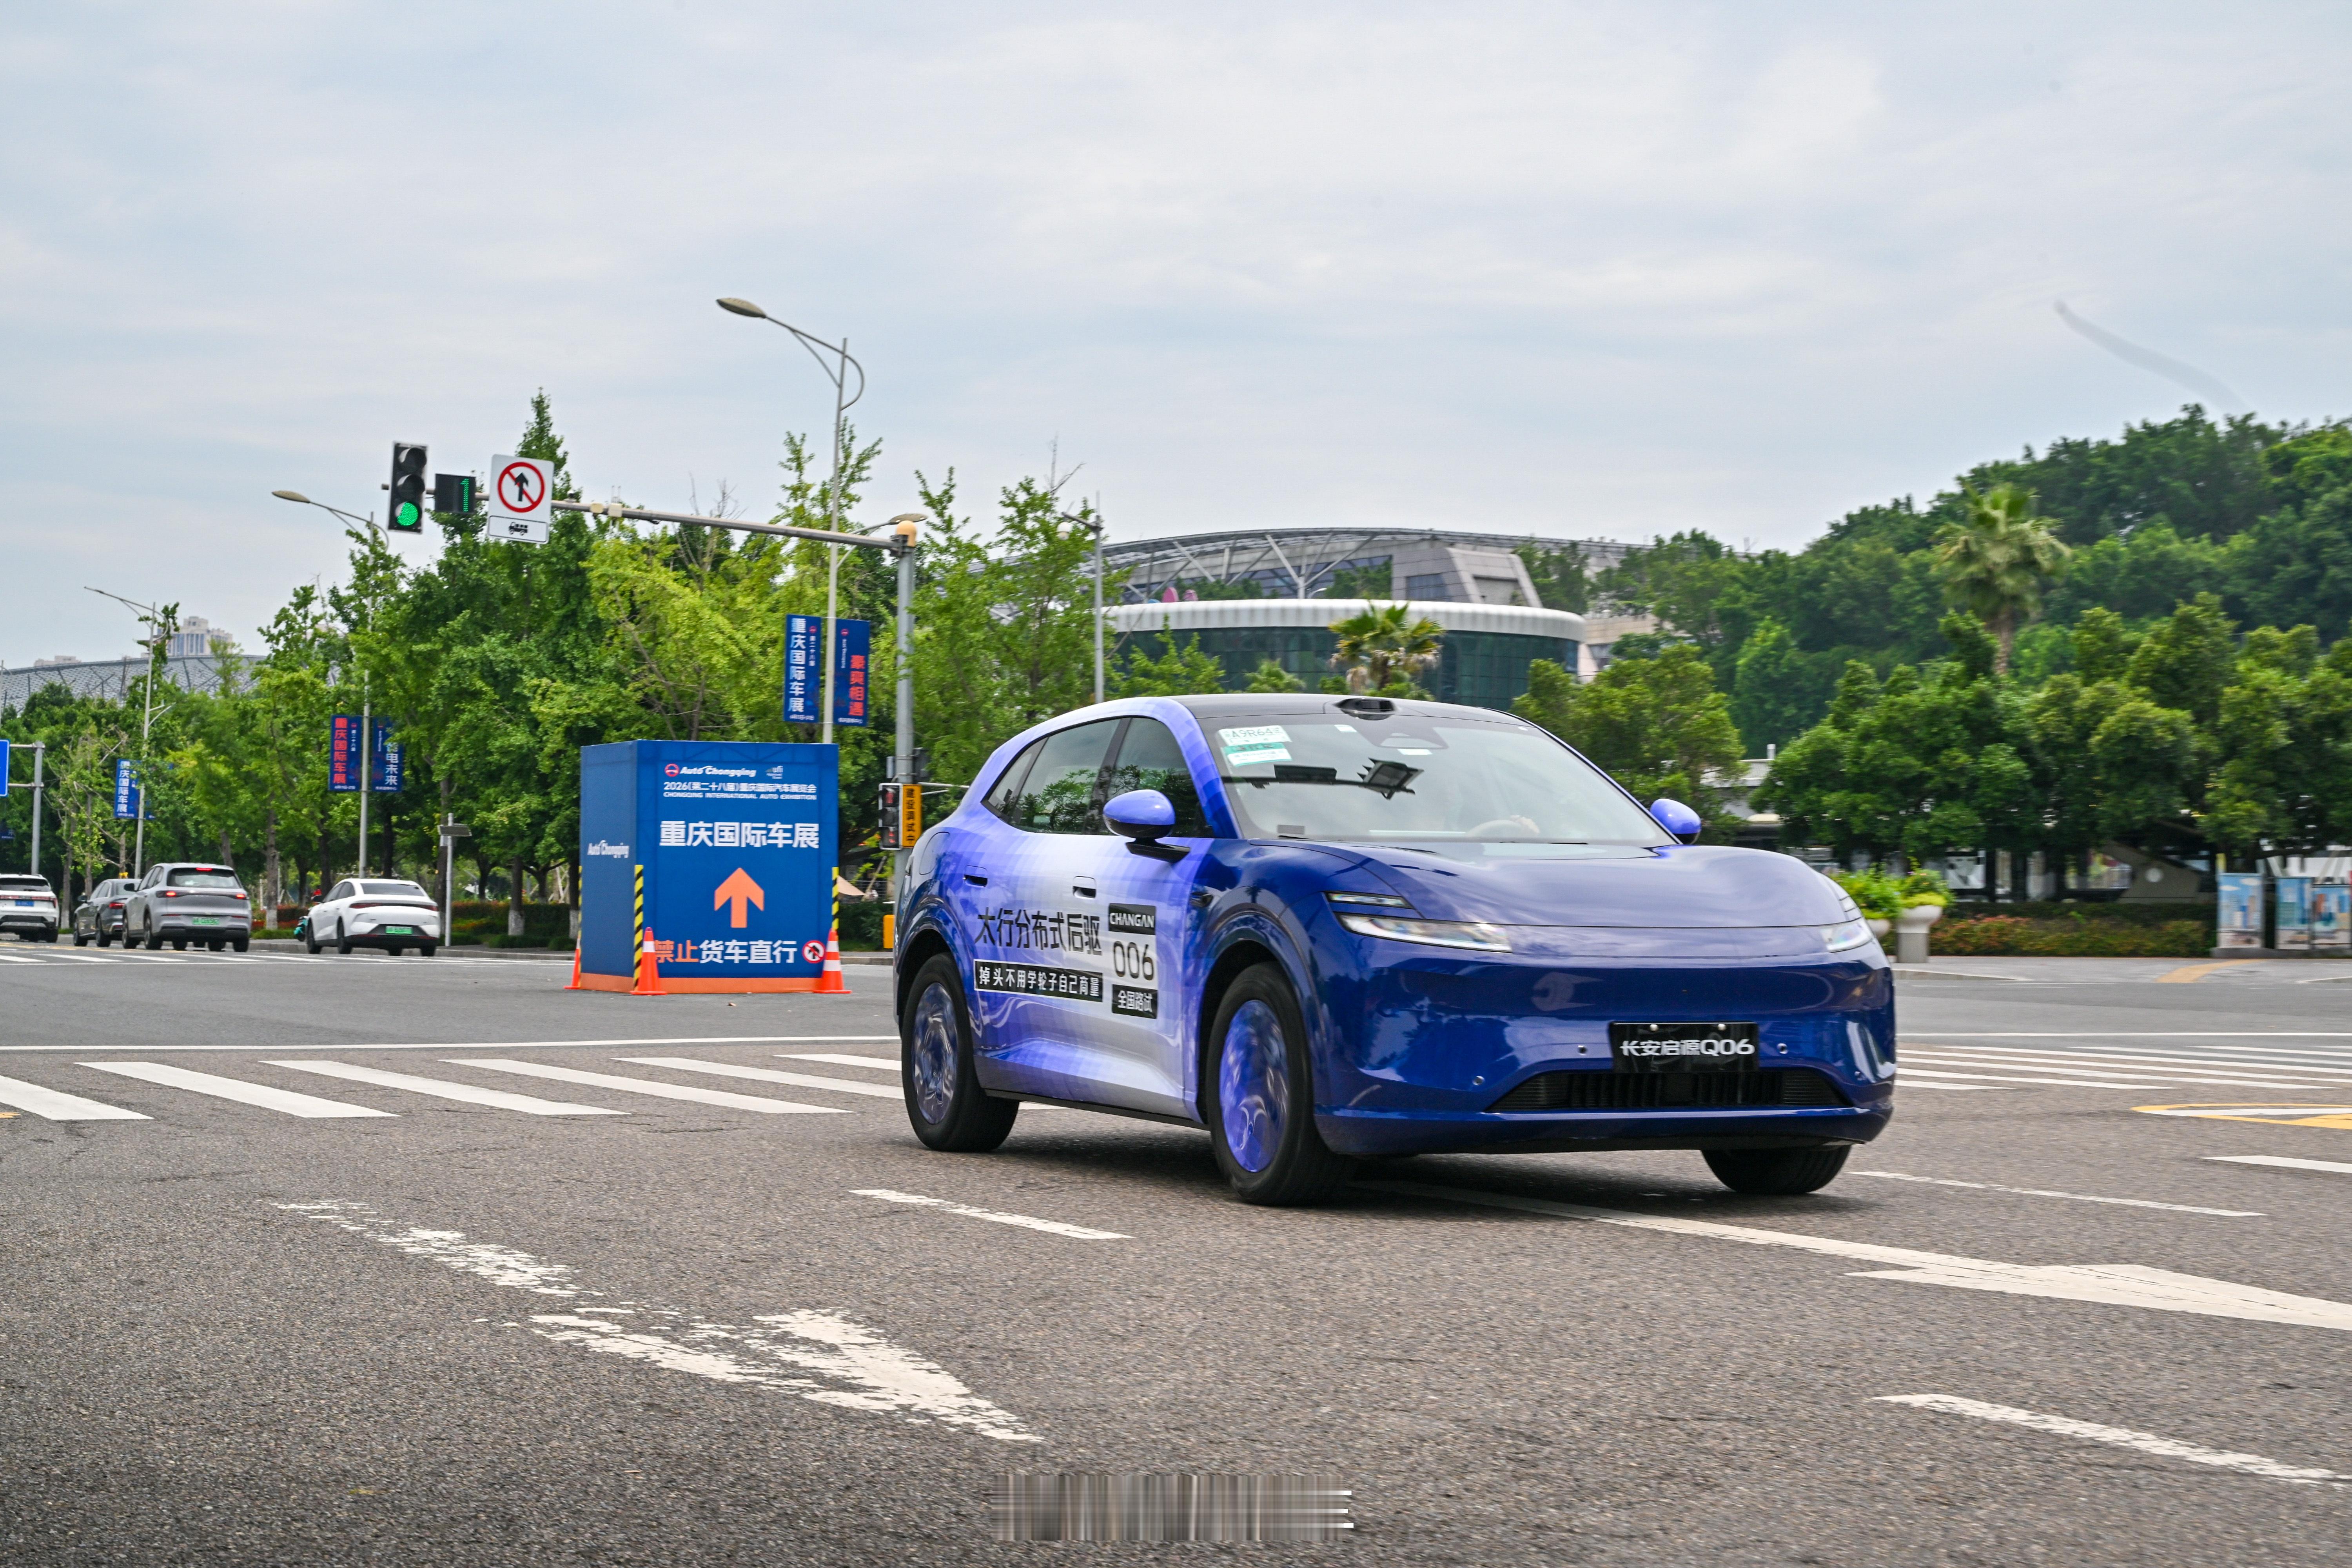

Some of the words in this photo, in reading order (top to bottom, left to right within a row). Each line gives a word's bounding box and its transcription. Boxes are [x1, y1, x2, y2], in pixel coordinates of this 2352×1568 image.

[788, 618, 806, 712] 重庆国际车展
[680, 766, 704, 775] Auto
[705, 766, 757, 777] Chongqing
[659, 820, 819, 849] 重庆国际车展
[975, 907, 1102, 956] 太行分布式后驱
[1109, 912, 1155, 928] CHANGAN
[655, 939, 798, 964] 禁止货车直行
[1112, 940, 1154, 981] 006
[979, 966, 1100, 997] 掉头不用学轮子自己商量
[1117, 989, 1153, 1013] 全国路试
[1619, 1039, 1756, 1056] 长安启源Q06
